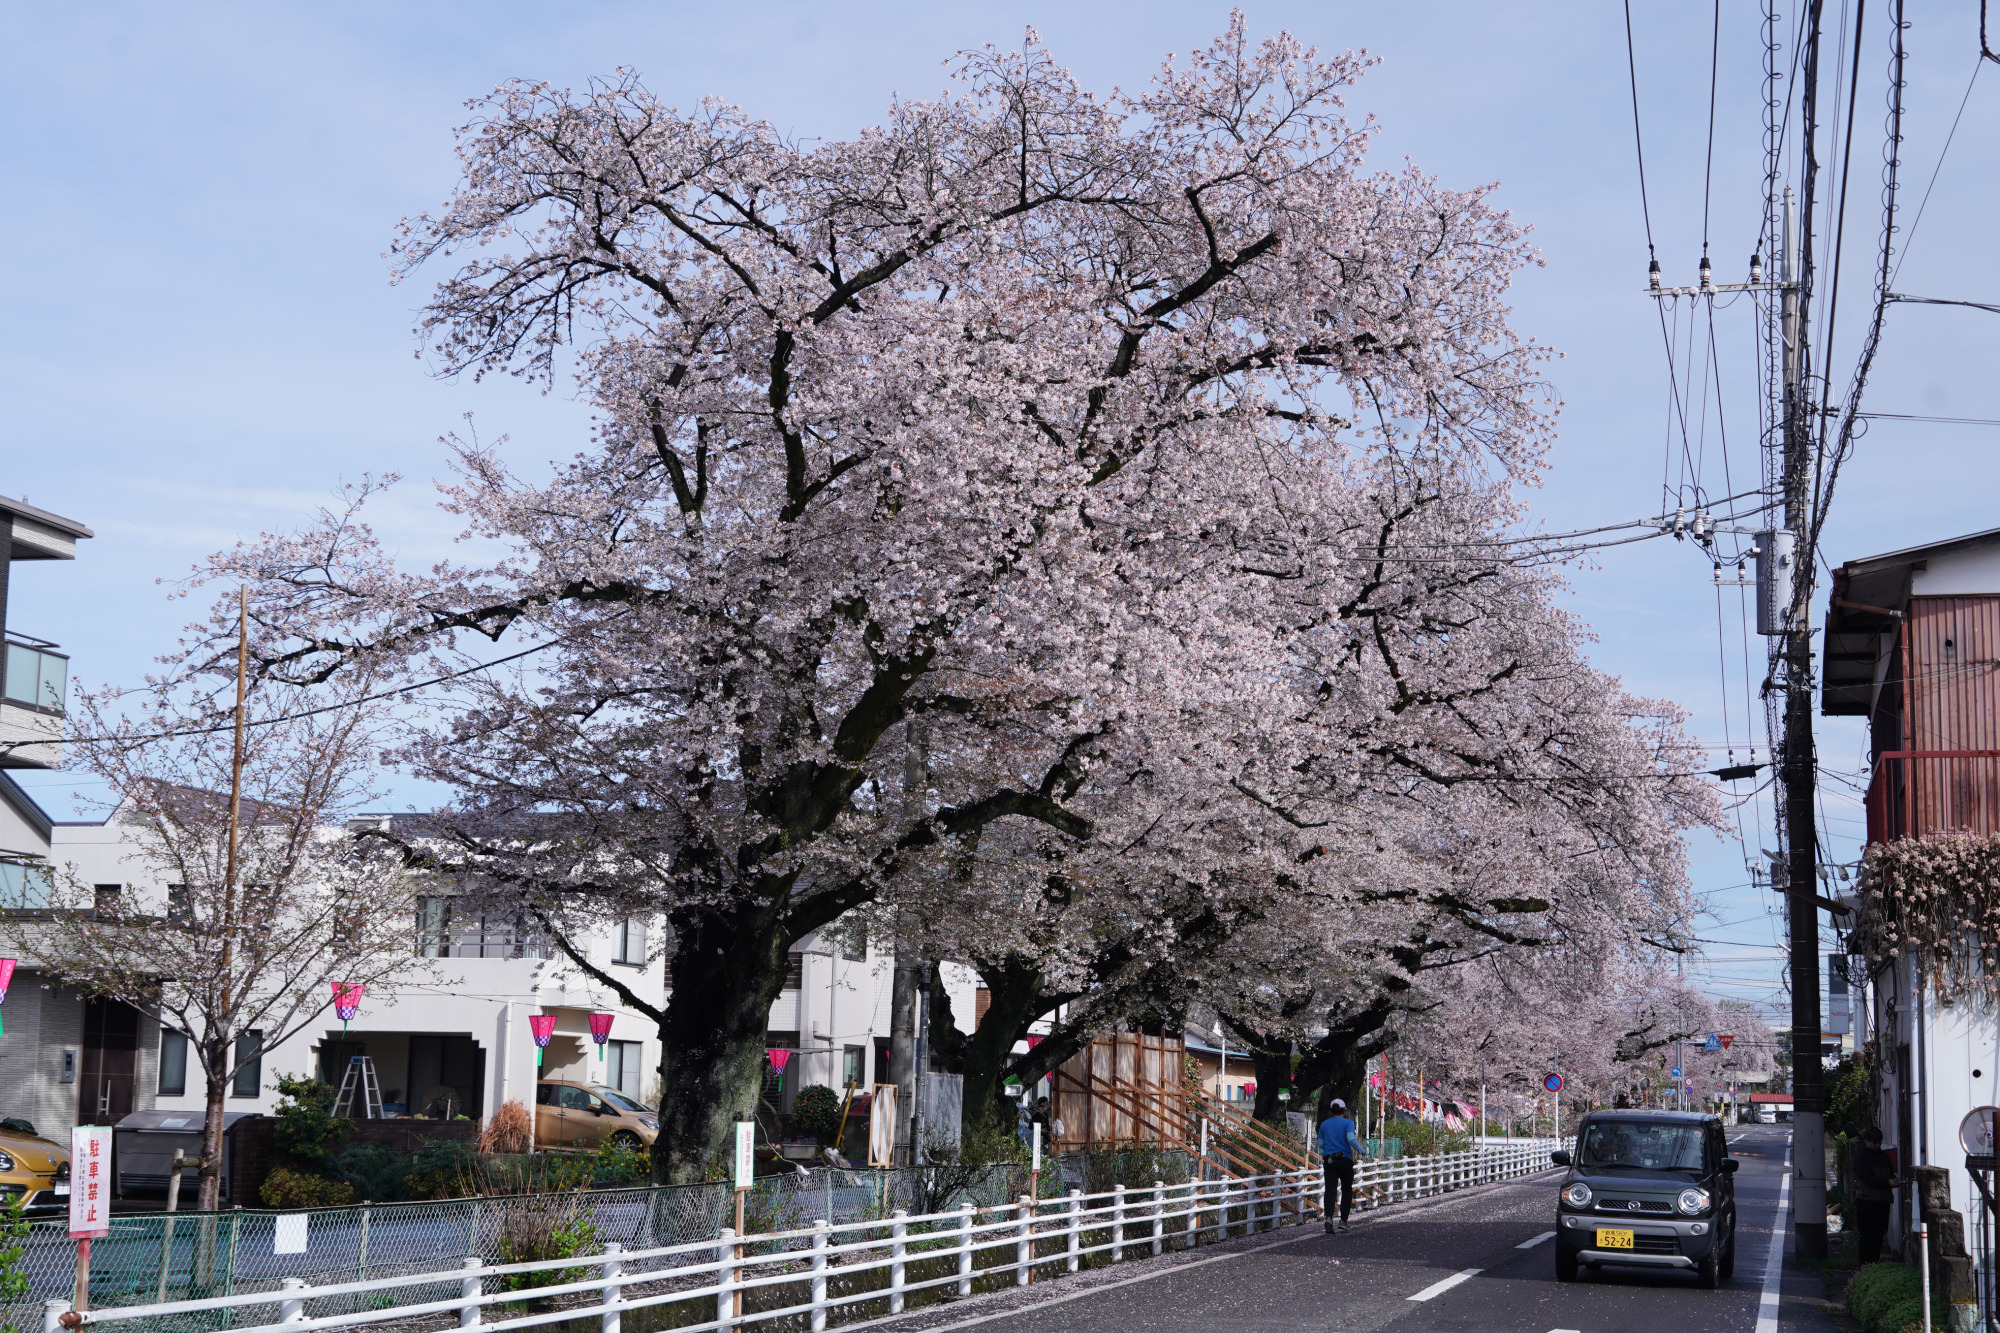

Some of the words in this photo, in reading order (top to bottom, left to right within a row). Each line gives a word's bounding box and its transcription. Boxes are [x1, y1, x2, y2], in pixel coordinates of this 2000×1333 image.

[87, 1140, 99, 1222] 駐車禁止
[1604, 1236, 1631, 1247] 52-24
